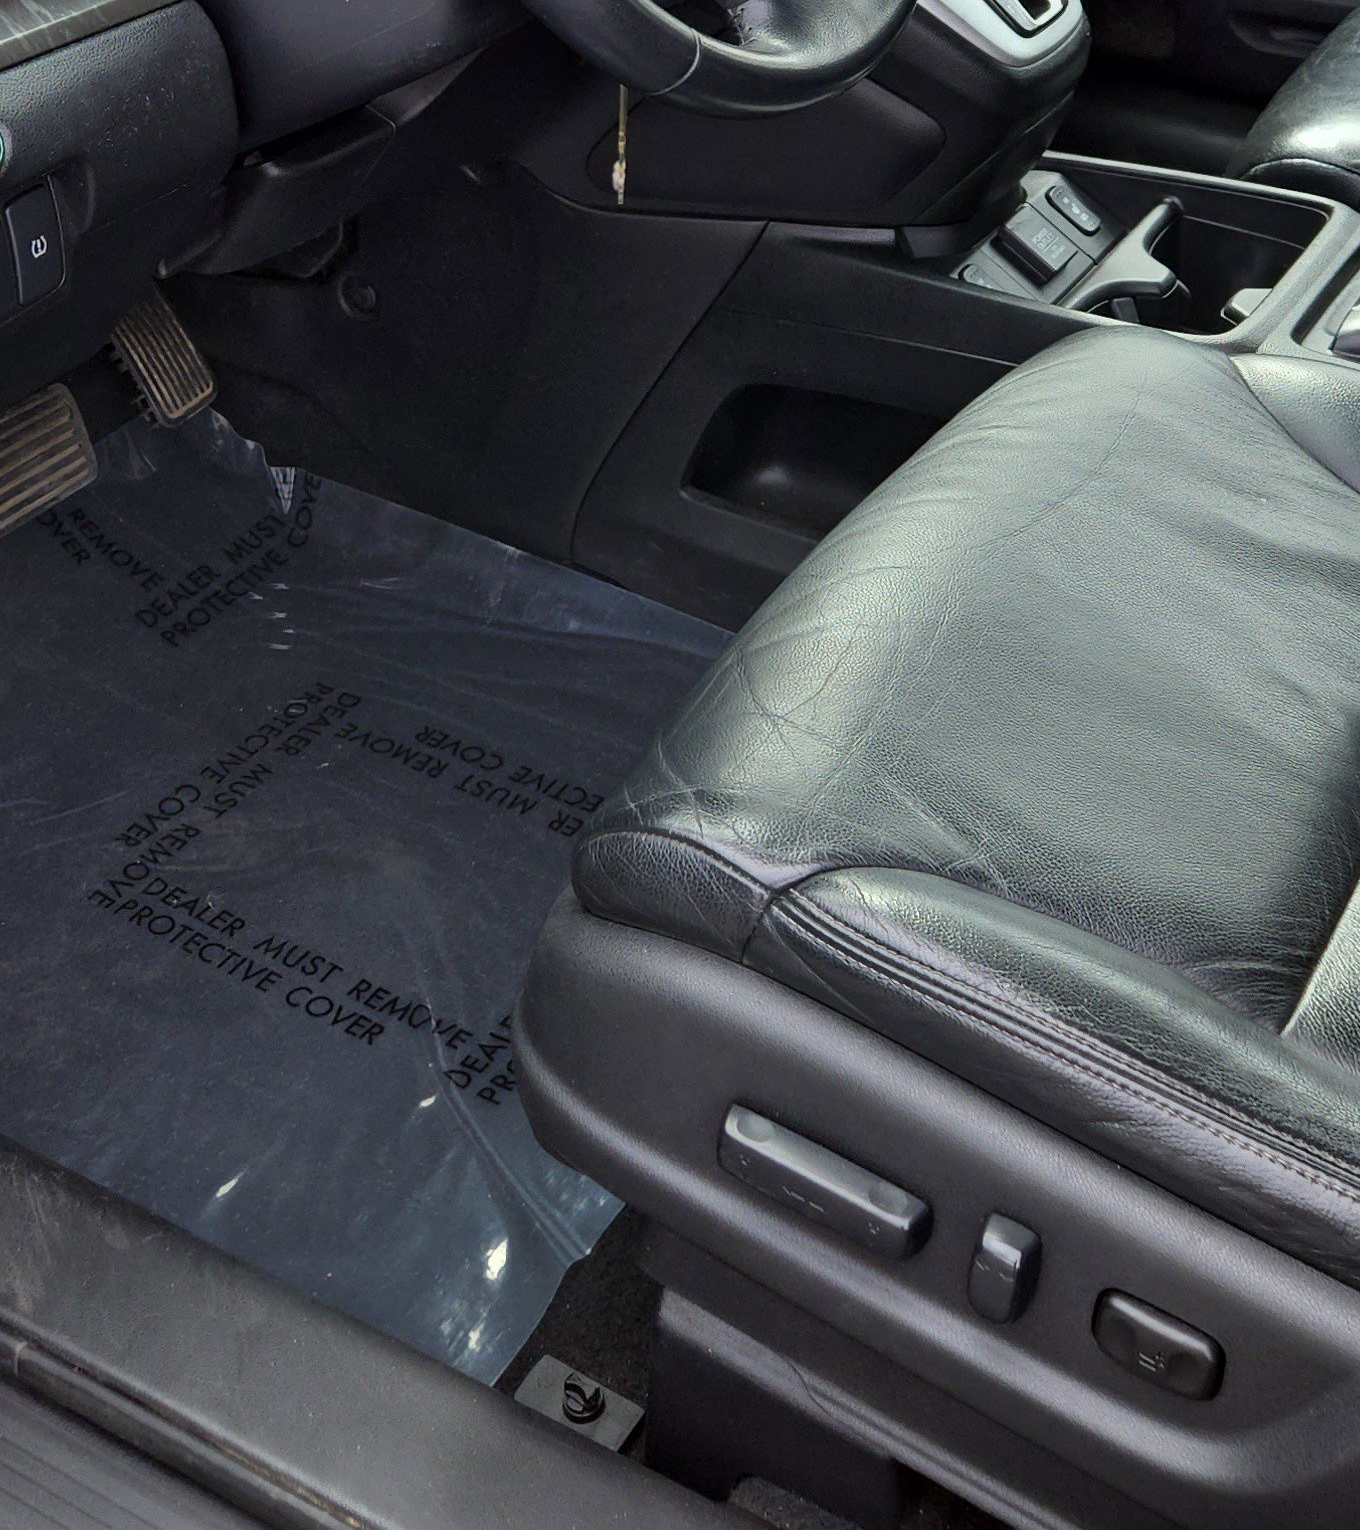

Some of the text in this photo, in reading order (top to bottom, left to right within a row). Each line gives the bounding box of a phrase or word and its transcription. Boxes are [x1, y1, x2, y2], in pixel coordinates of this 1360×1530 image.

[69, 508, 165, 592] REMOVE
[135, 512, 287, 628] DEALER MUST
[160, 548, 289, 647] PROTECTIVE
[87, 691, 361, 909] DEALER MUST REMOVE
[114, 681, 334, 847] PROTECTIVE COVER
[333, 722, 449, 778] REMOVE
[414, 725, 505, 771] COVER
[454, 774, 538, 816] MUST
[118, 899, 386, 1046] PROTECTIVE COVER
[142, 878, 473, 1049] DEALER MUST REMOVE
